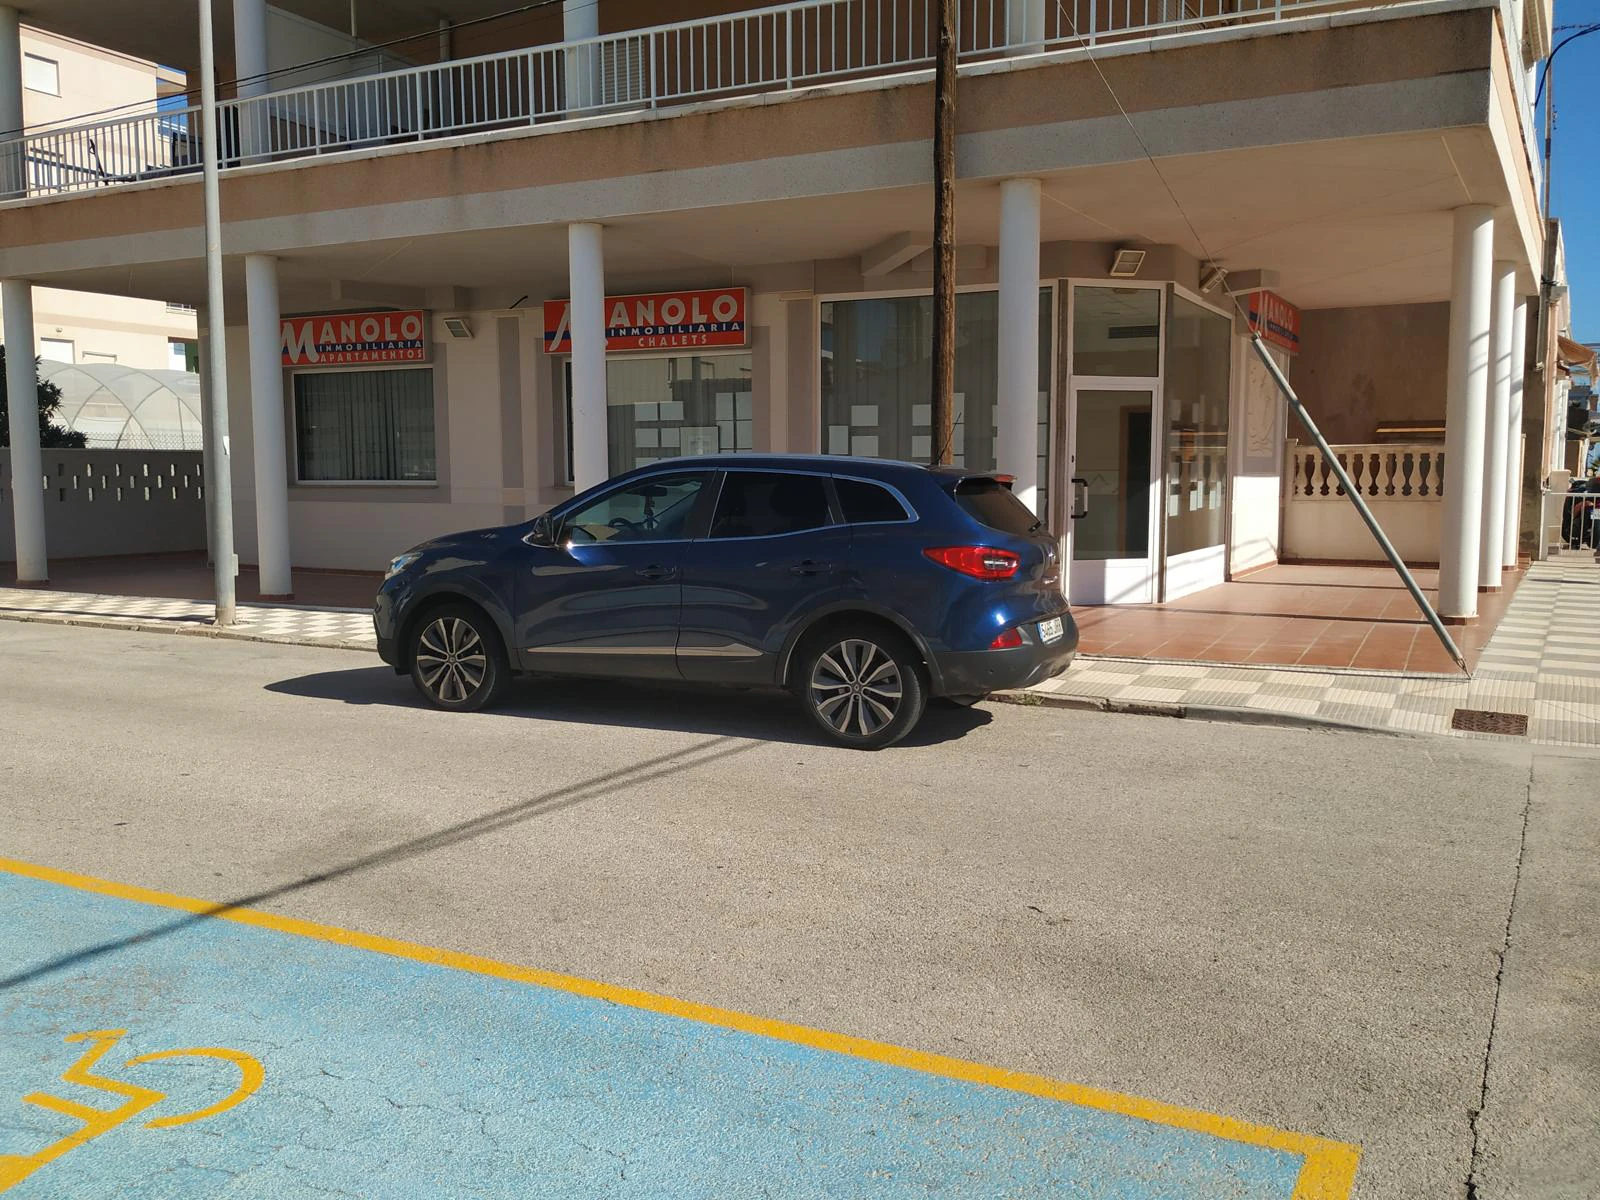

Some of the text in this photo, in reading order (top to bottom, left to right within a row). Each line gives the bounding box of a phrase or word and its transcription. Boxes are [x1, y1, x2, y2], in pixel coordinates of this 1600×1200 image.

[611, 323, 740, 337] INMOBILIARIA
[281, 315, 422, 363] MANOLO
[638, 334, 707, 347] CHALETS
[319, 341, 422, 352] INMOBILIARIA
[320, 349, 422, 362] APARTAMENTOS
